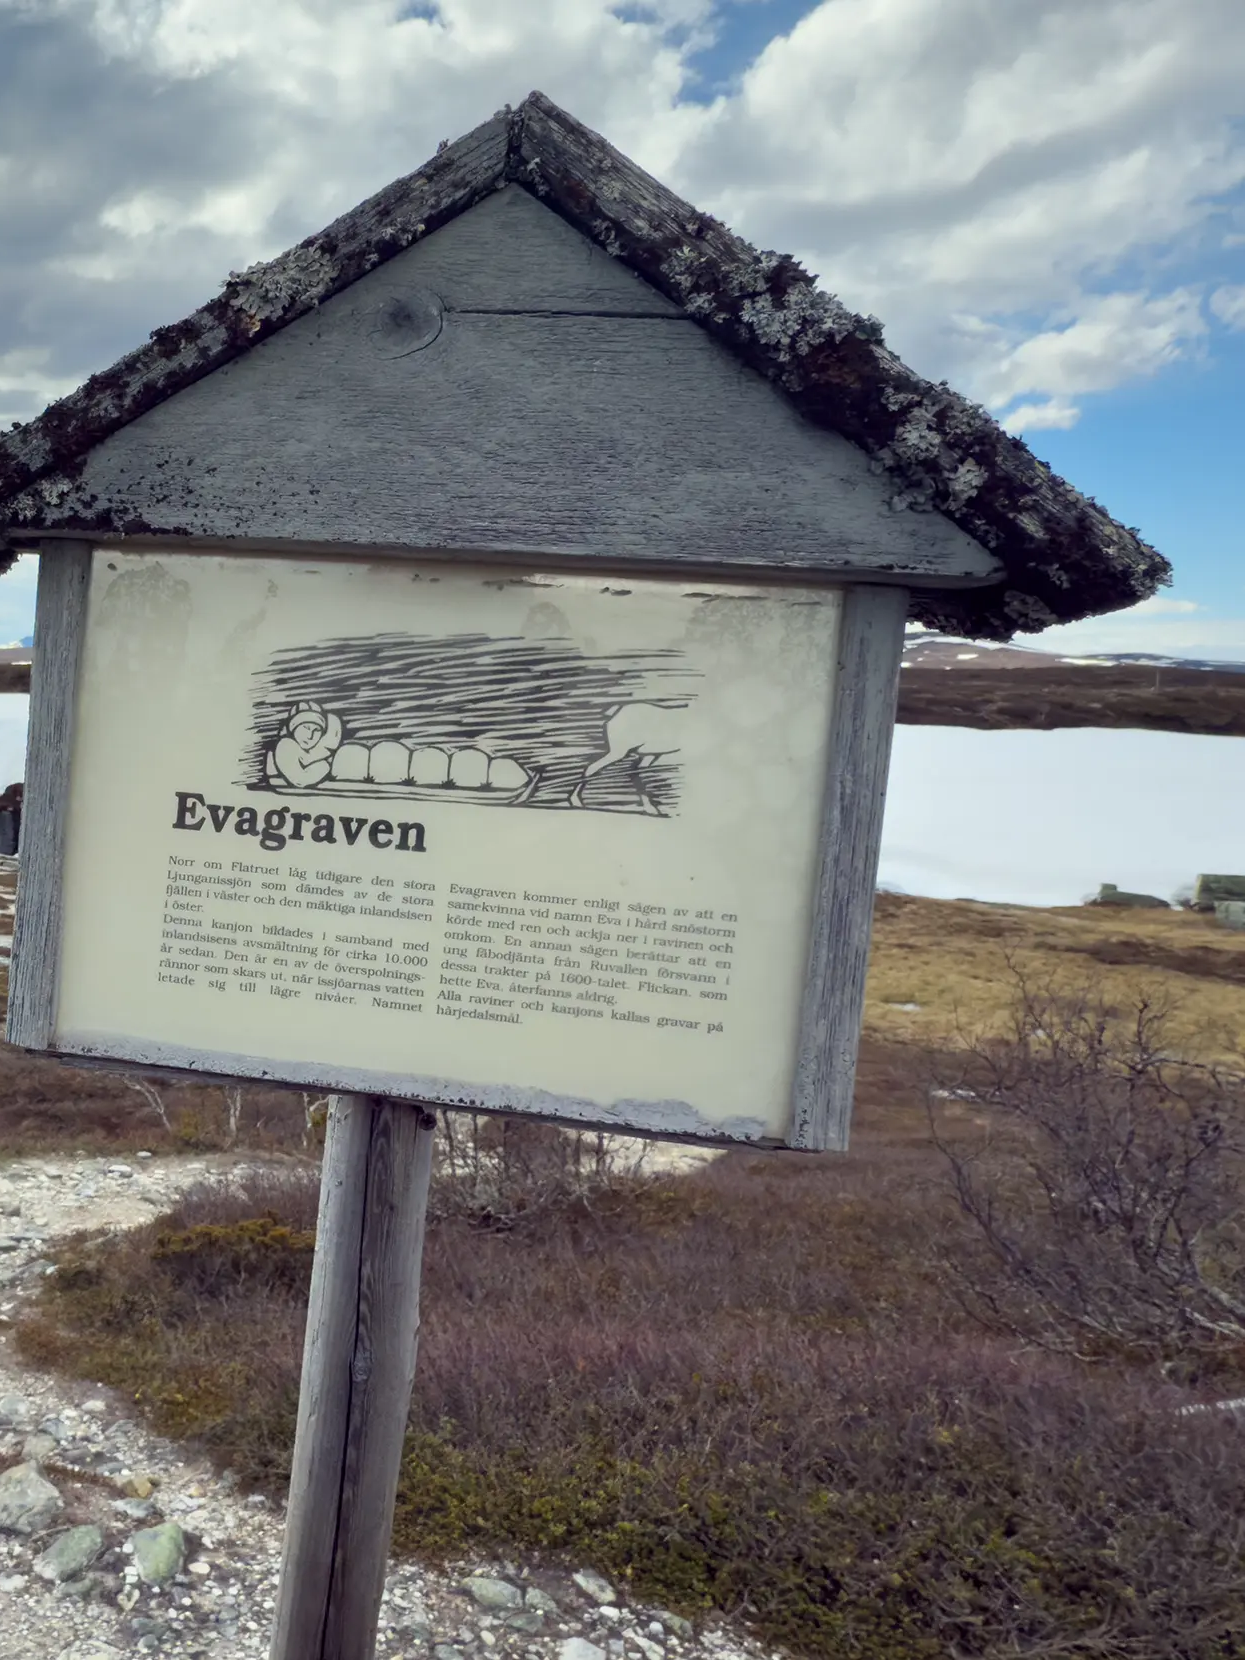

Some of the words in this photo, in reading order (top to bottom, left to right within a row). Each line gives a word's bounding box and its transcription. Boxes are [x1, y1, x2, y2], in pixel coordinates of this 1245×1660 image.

[172, 791, 427, 852] Evagraven
[167, 870, 252, 889] Ljunganissjön
[261, 882, 286, 892] som
[296, 884, 344, 897] dämdes
[354, 891, 367, 899] av
[377, 892, 393, 902] de
[402, 894, 434, 906] stora
[169, 856, 195, 866] Norr
[204, 860, 222, 870] om
[231, 862, 280, 875] Flatruet
[289, 866, 307, 880] låg
[315, 870, 362, 884] tidigare
[371, 876, 394, 888] den
[403, 880, 435, 892] stora
[166, 886, 202, 898] fjällen
[213, 890, 249, 902] väster
[254, 894, 275, 905] och
[279, 896, 301, 908] den
[306, 900, 355, 914] mäktiga
[360, 905, 432, 922] inlandsisen
[447, 900, 525, 916] samekvinna
[530, 908, 549, 919] vid
[554, 912, 592, 924] namn
[597, 914, 621, 926] Eva
[635, 918, 667, 931] hård
[671, 923, 735, 938] snöstorm
[450, 884, 516, 900] Evagraven
[523, 891, 577, 906] kommer
[584, 898, 620, 912] enligt
[627, 902, 666, 916] sägen
[673, 908, 688, 916] av
[695, 910, 714, 920] att
[721, 912, 737, 922] en
[162, 930, 237, 946] inlandsisens
[243, 937, 318, 956] avsmältning
[323, 946, 340, 957] för
[346, 950, 377, 962] cirka
[385, 953, 428, 967] 10.000
[163, 914, 202, 927] Denna
[211, 919, 253, 934] kanjon
[262, 925, 313, 939] bildades
[335, 933, 393, 948] samband
[403, 940, 429, 952] med
[446, 914, 482, 927] körde
[487, 918, 515, 930] med
[520, 924, 541, 932] ren
[547, 924, 570, 936] och
[575, 928, 610, 942] ackja
[617, 932, 638, 944] ner
[653, 938, 703, 950] ravinen
[709, 942, 733, 954] och
[160, 943, 173, 953] år
[224, 950, 248, 962] Den
[255, 953, 267, 964] är
[273, 956, 288, 966] en
[294, 959, 308, 968] av
[314, 960, 329, 970] de
[443, 946, 467, 958] ung
[475, 948, 545, 965] fäbodjänta
[554, 956, 581, 968] från
[591, 960, 647, 976] Ruvallen
[657, 968, 716, 984] försvann
[504, 936, 521, 946] En
[529, 940, 571, 952] annan
[580, 944, 618, 958] sägen
[627, 948, 680, 964] berättar
[688, 956, 707, 966] att
[715, 960, 731, 970] en
[158, 972, 195, 986] letade
[208, 979, 226, 992] sig
[239, 982, 255, 992] till
[270, 985, 301, 999] lägre
[371, 998, 423, 1012] Namnet
[159, 959, 199, 971] rännor
[204, 964, 228, 974] som
[233, 966, 266, 980] skars
[291, 974, 311, 984] när
[317, 976, 381, 993] issjöarnas
[385, 984, 424, 998] vatten
[440, 975, 471, 987] hette
[509, 982, 571, 999] återfanns
[441, 960, 477, 973] dessa
[484, 964, 529, 979] trakter
[535, 970, 551, 982] på
[699, 989, 727, 1000] som
[437, 990, 461, 1002] Alla
[469, 994, 513, 1008] raviner
[521, 1000, 543, 1011] och
[551, 1002, 603, 1018] kanjons
[611, 1009, 650, 1023] kallas
[657, 1016, 700, 1030] gravar
[707, 1022, 723, 1034] på
